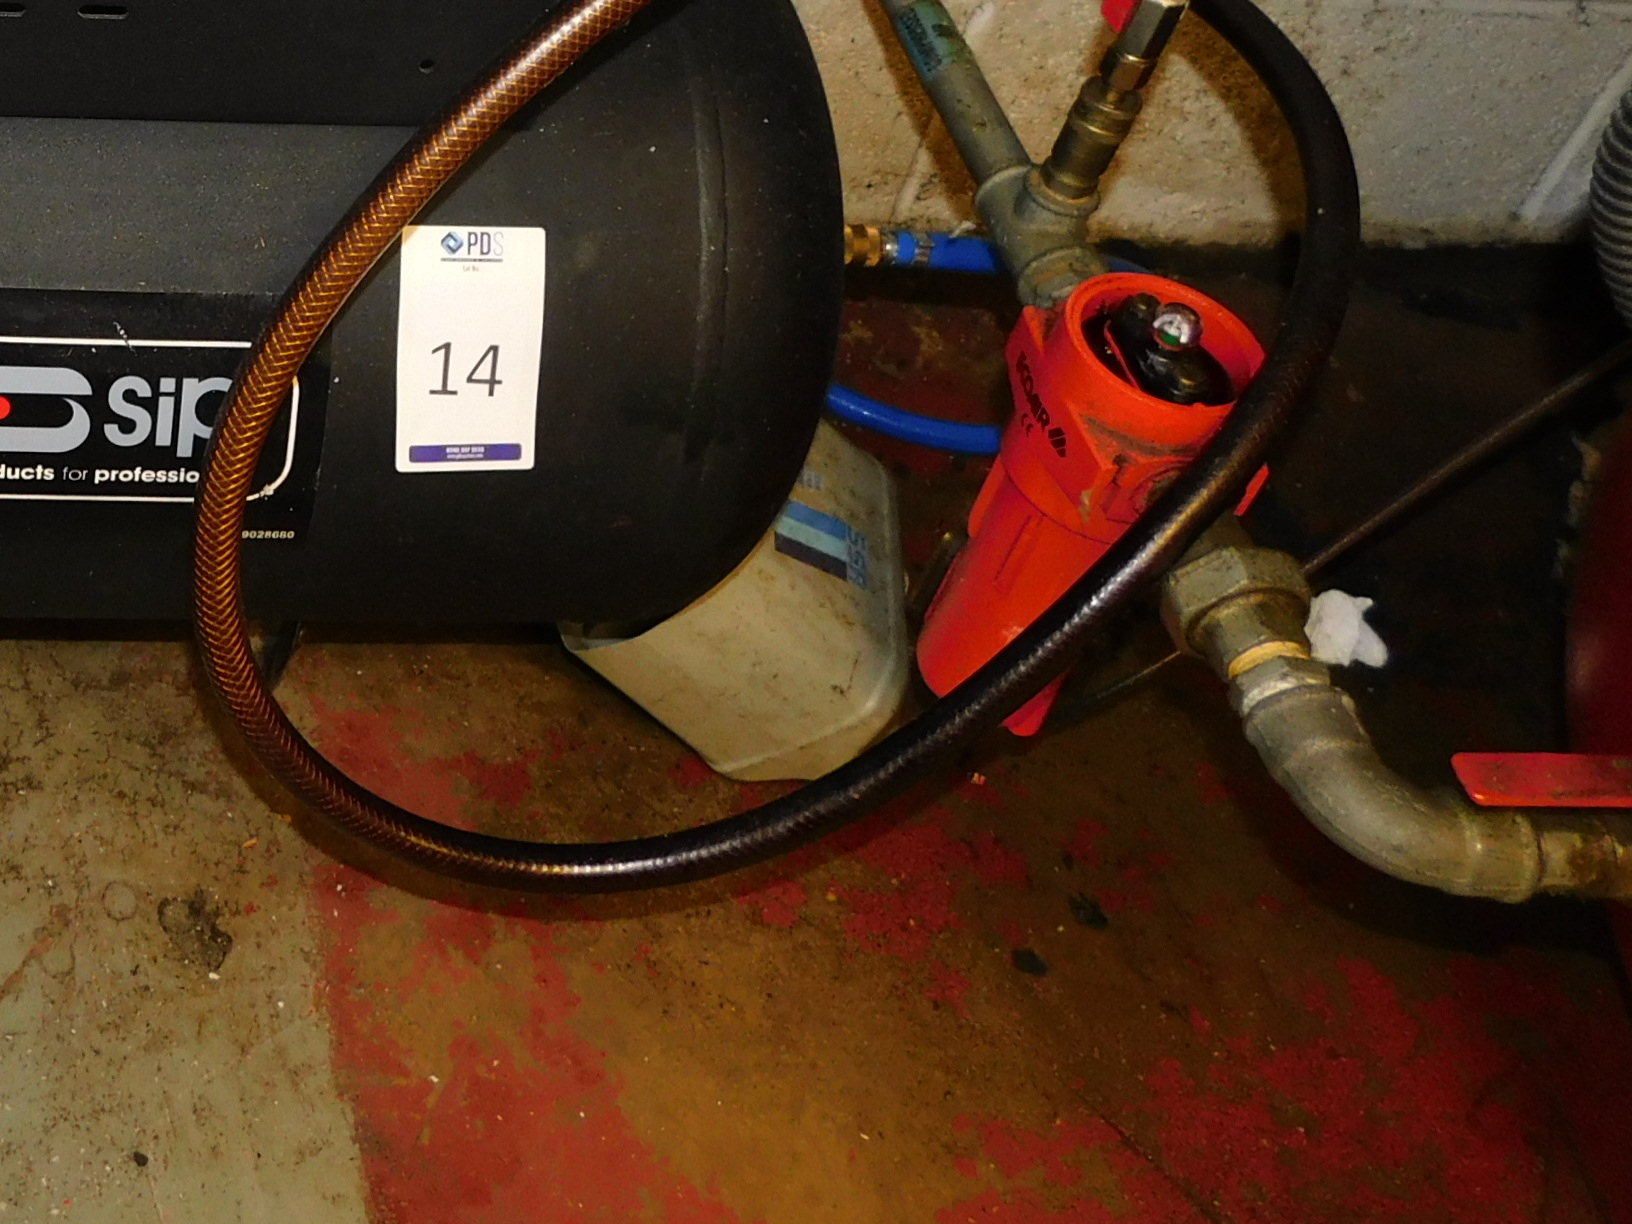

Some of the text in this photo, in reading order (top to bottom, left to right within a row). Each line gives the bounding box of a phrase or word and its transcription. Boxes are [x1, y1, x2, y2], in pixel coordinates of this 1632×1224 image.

[429, 341, 503, 397] 14
[62, 466, 88, 482] for
[93, 466, 200, 484] professio
